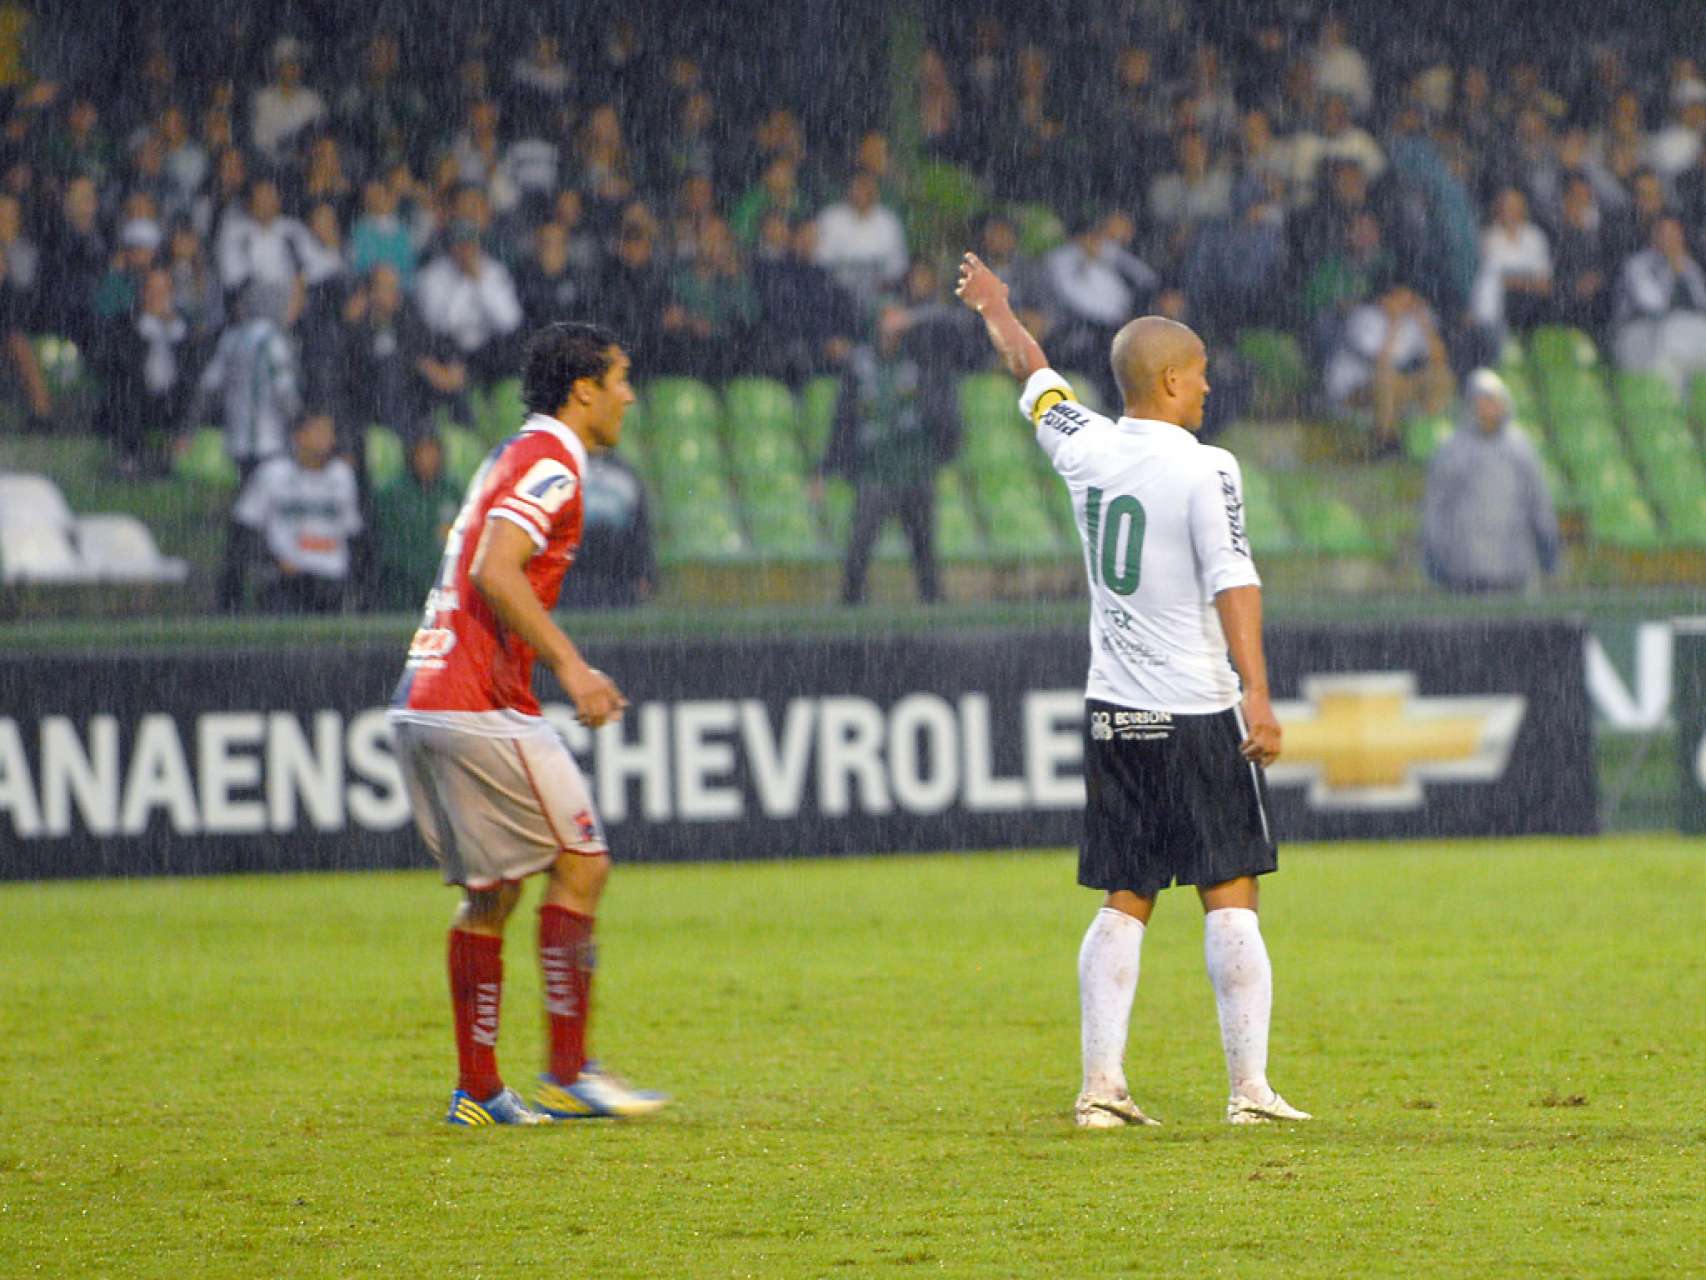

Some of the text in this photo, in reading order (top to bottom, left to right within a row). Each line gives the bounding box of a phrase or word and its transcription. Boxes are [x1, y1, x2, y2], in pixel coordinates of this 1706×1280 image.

[1085, 486, 1147, 596] 10
[0, 690, 1087, 838] ANAENS HEVROLE
